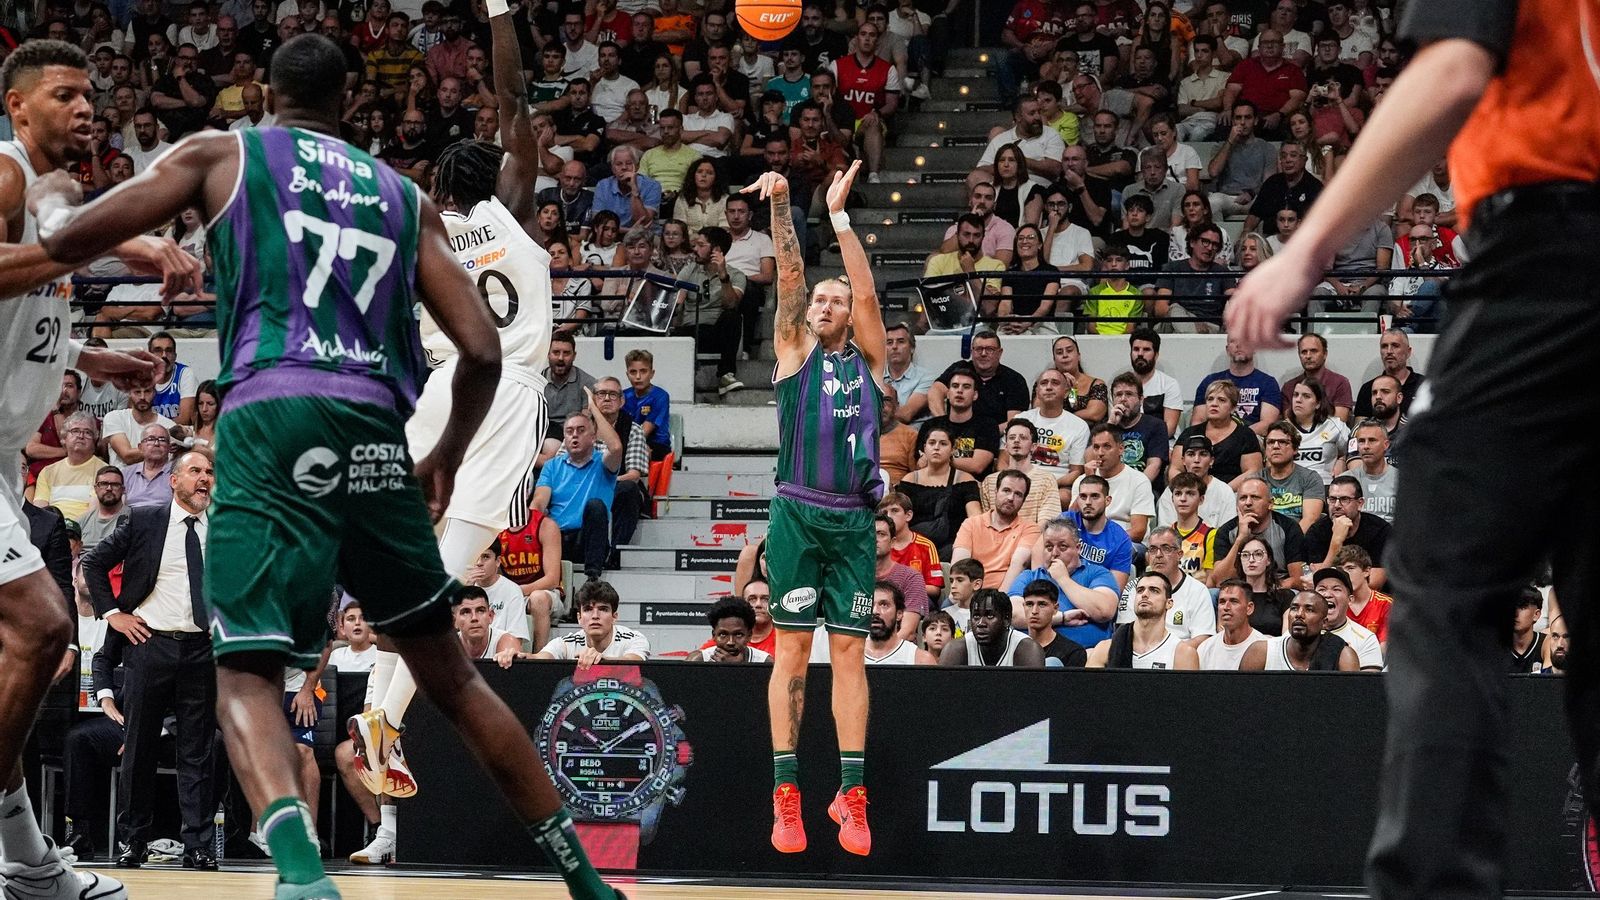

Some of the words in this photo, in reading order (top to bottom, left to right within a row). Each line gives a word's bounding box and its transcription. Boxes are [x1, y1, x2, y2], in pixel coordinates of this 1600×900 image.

[844, 89, 875, 104] JVC
[297, 138, 373, 179] Sima
[284, 210, 397, 315] 77
[26, 316, 61, 364] 22
[350, 443, 405, 462] COSTA
[847, 433, 857, 460] 1
[349, 463, 379, 479] DEL
[597, 679, 619, 689] 60
[598, 699, 616, 711] 12
[645, 742, 657, 756] 3
[927, 780, 1170, 837] LOTUS
